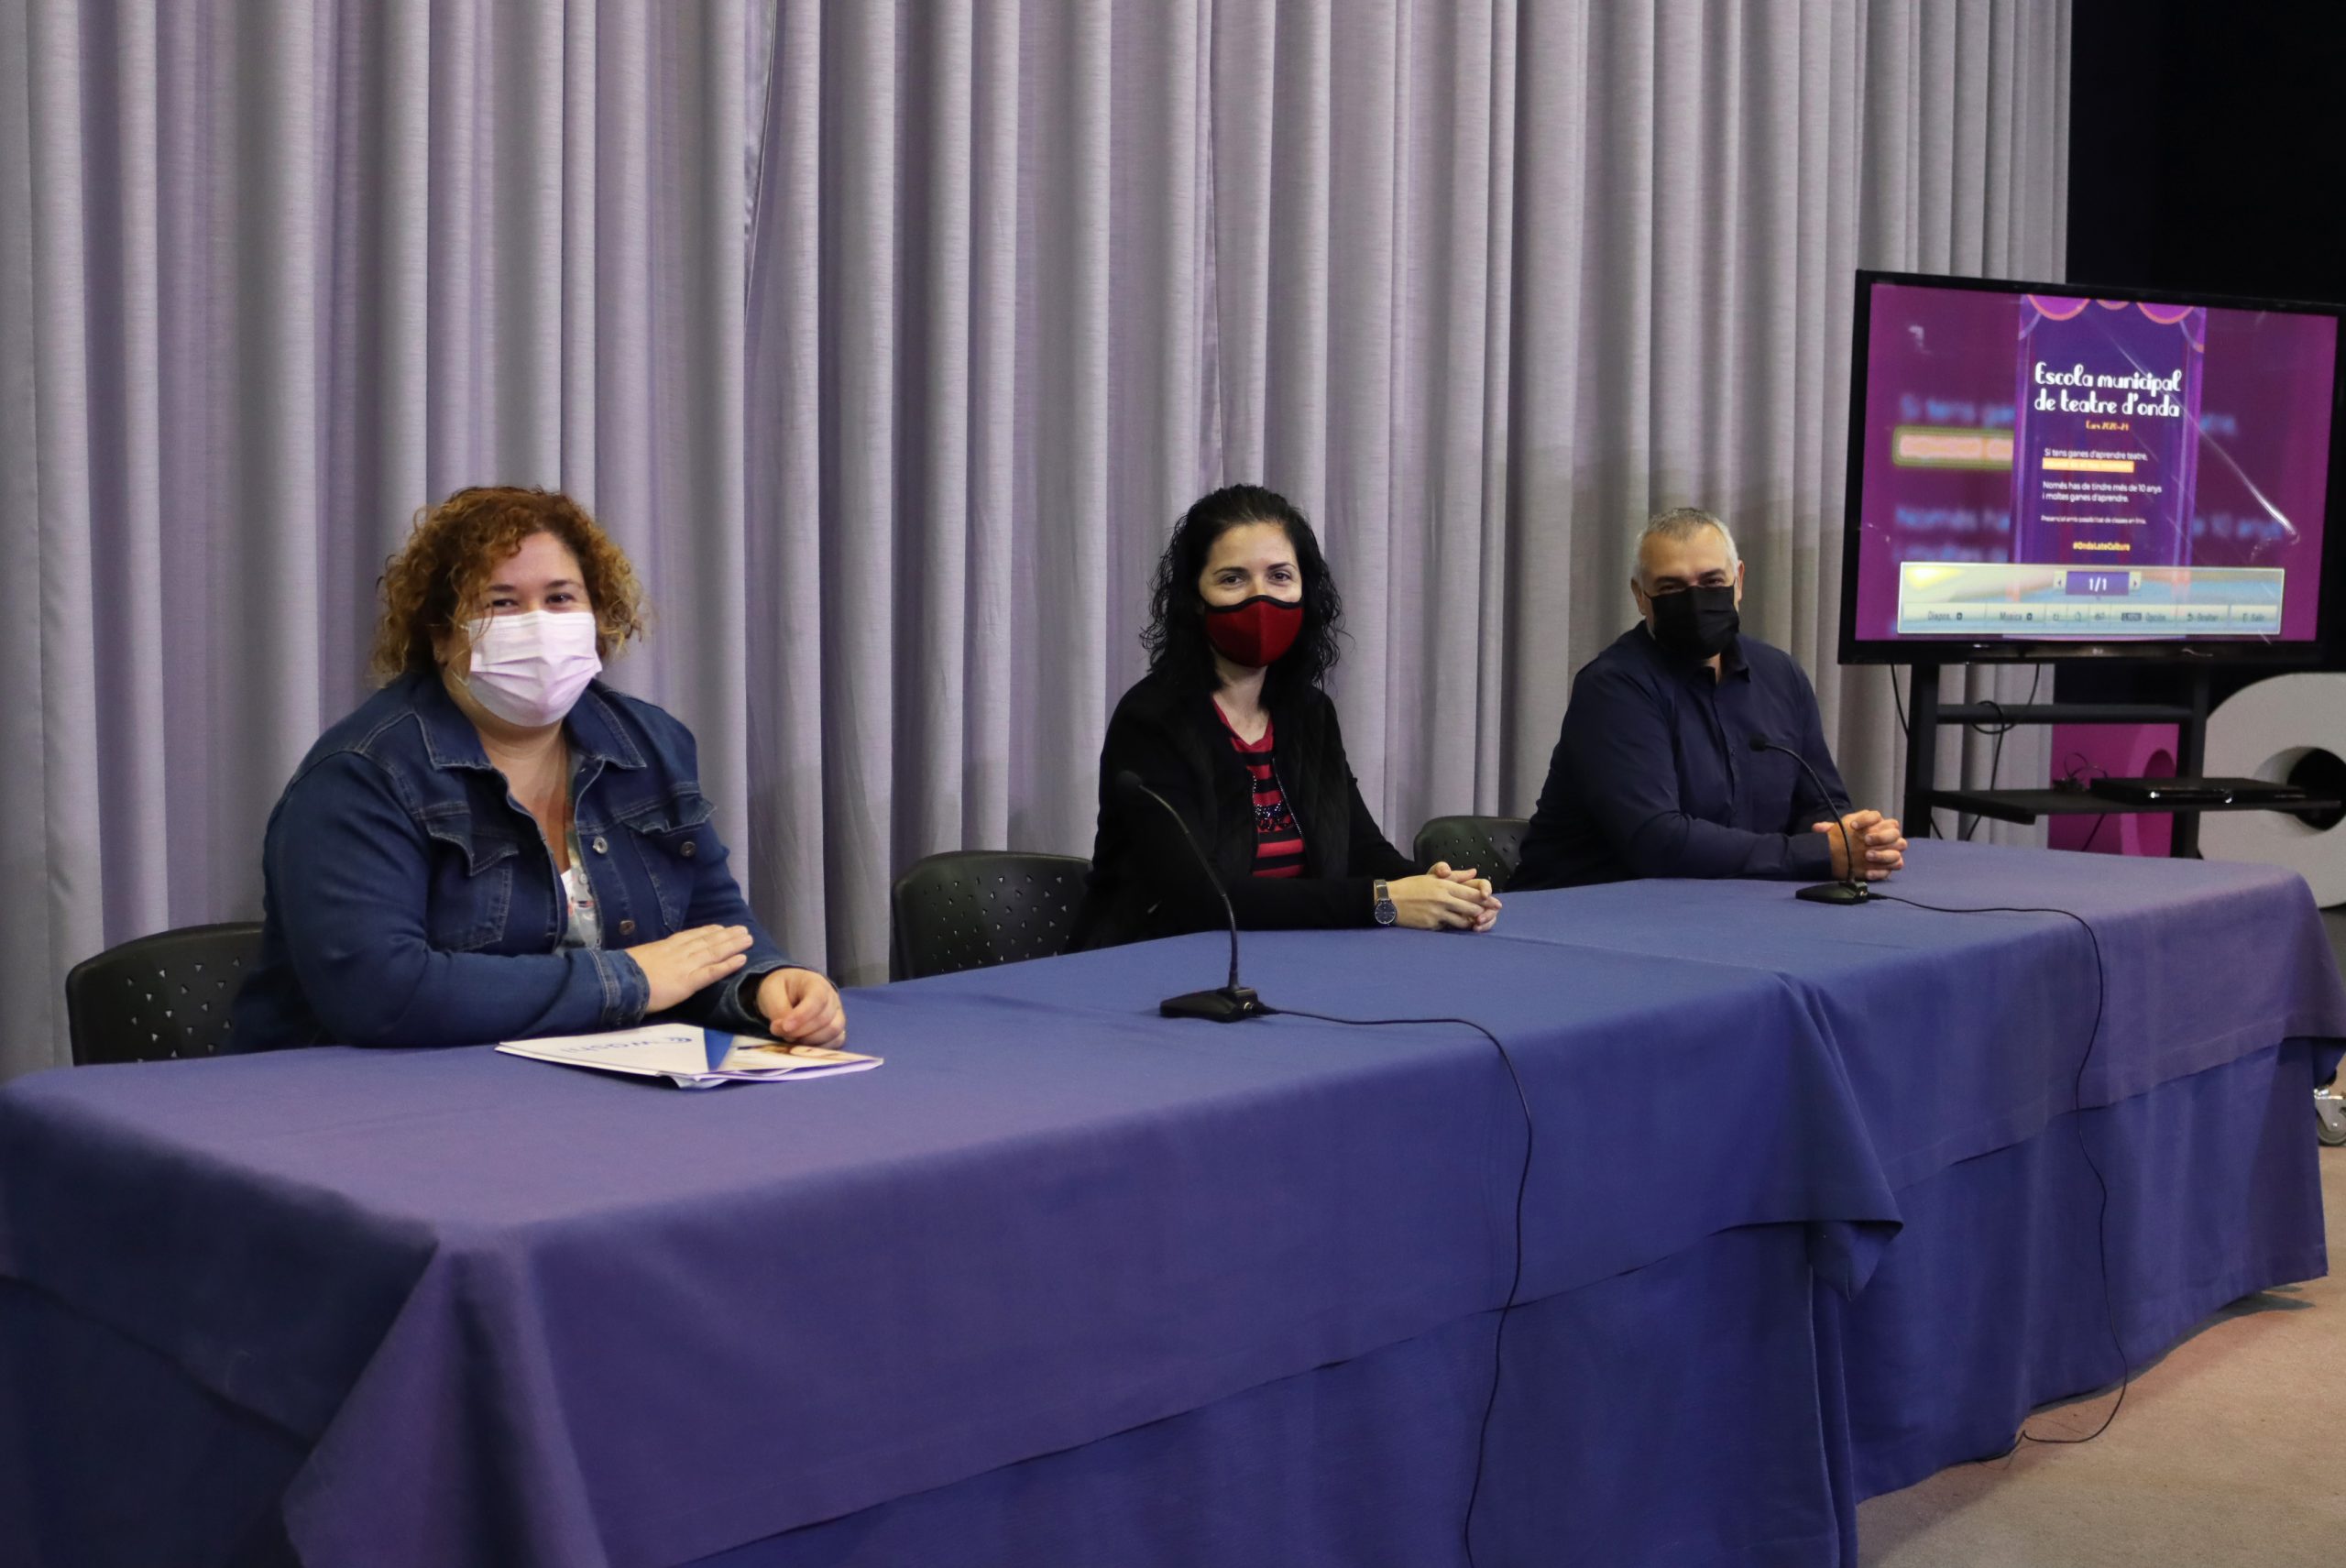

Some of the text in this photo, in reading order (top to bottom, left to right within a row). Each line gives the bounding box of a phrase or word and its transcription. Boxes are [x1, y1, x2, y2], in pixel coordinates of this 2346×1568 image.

[2034, 361, 2183, 397] Escola municipal
[2034, 388, 2180, 417] de teatre d'onda
[2088, 576, 2108, 592] 1/1
